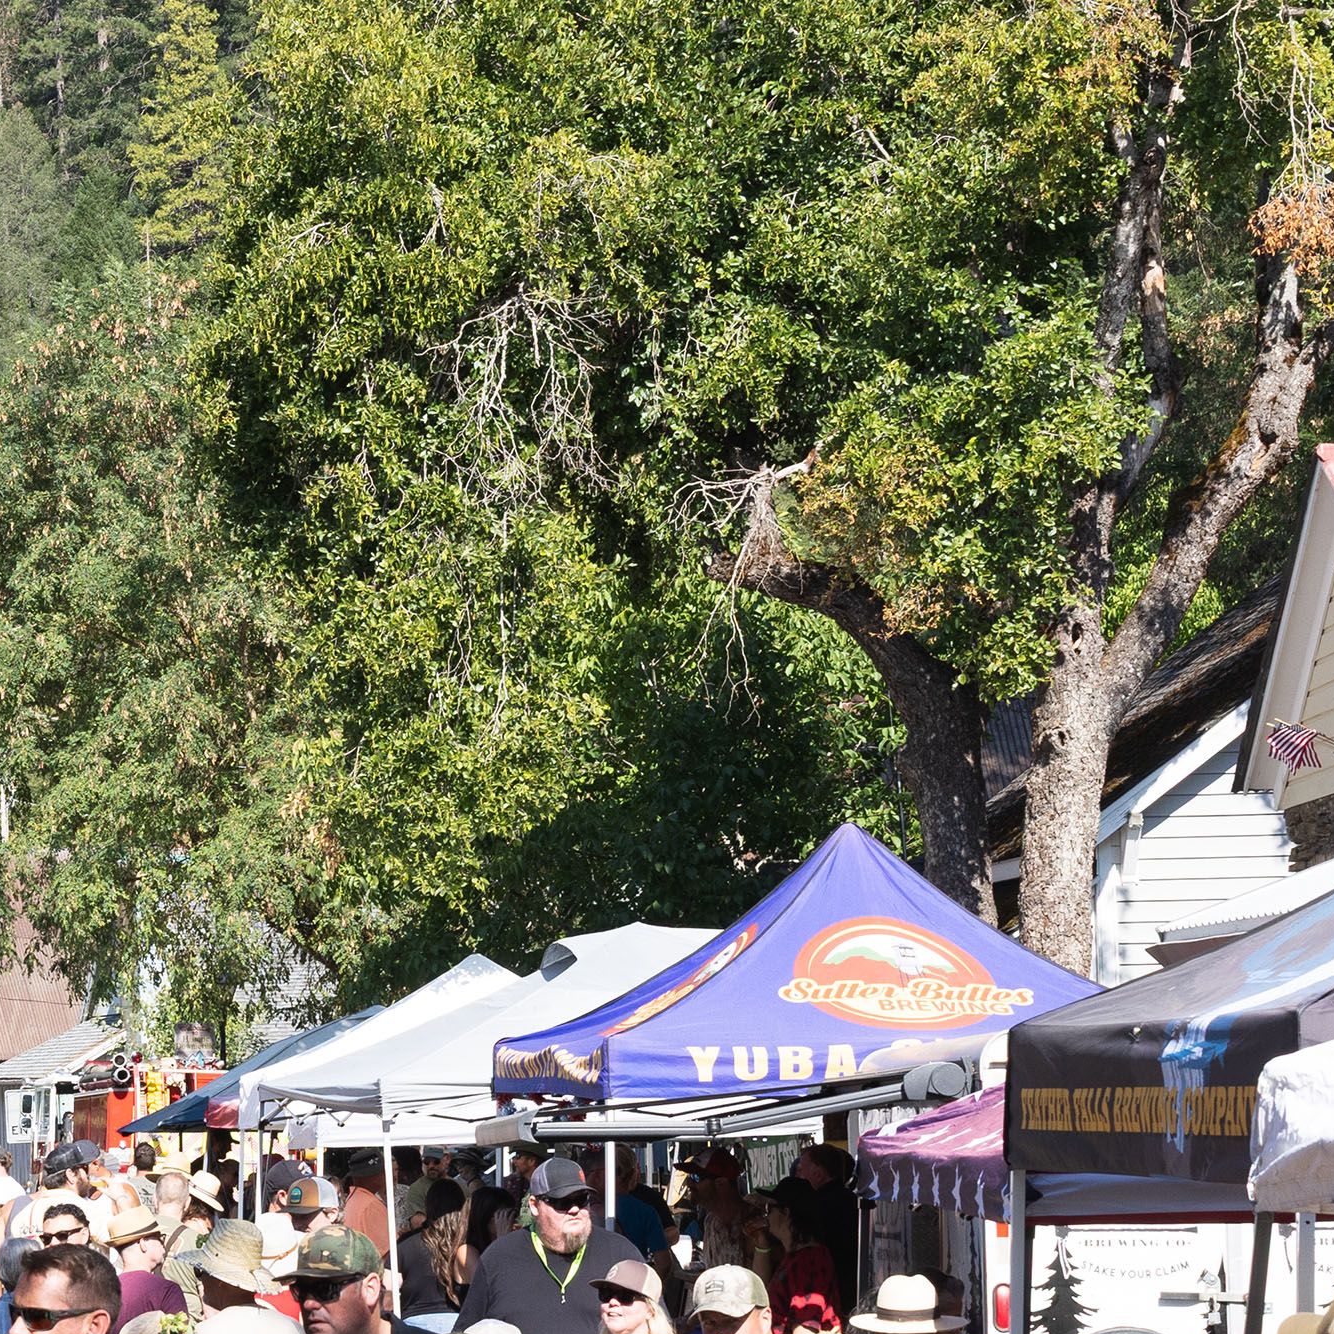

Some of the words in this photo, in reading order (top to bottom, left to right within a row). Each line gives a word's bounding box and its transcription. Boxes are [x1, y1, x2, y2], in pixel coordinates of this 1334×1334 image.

[781, 980, 896, 1001] Sutter
[909, 981, 1032, 1004] Buttes
[877, 1000, 1012, 1015] BREWING
[685, 1044, 858, 1083] YUBA
[1021, 1087, 1073, 1132] FEATHER
[1072, 1086, 1112, 1133] FALLS
[1113, 1086, 1179, 1135] BREWING
[1181, 1085, 1257, 1137] COMPANY
[1084, 1239, 1160, 1247] BREWING
[1081, 1260, 1115, 1278] STAKE
[1120, 1269, 1153, 1279] YOUR
[1155, 1260, 1191, 1278] CLAIM
